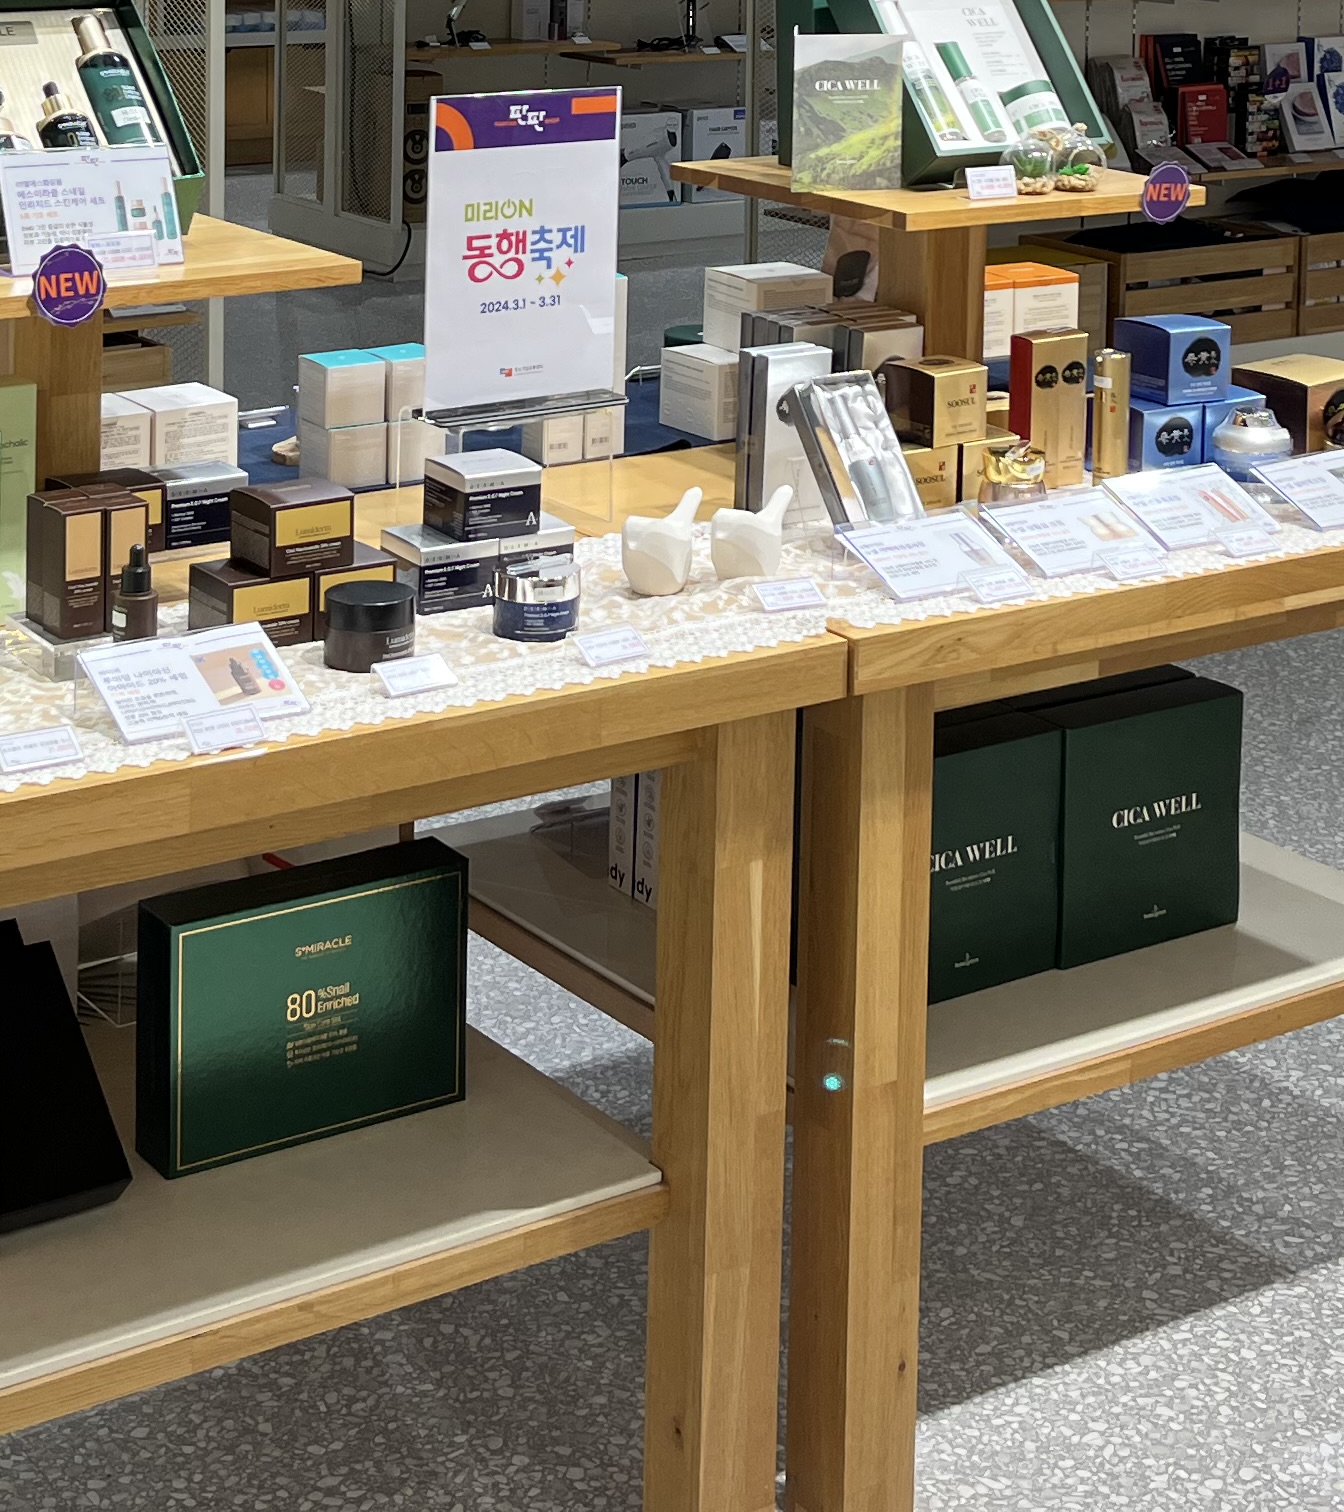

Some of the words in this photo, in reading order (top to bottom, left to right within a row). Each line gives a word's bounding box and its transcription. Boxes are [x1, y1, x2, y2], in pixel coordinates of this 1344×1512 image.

[967, 17, 998, 27] WELL
[815, 80, 843, 91] CICA
[846, 79, 881, 90] WELL
[1267, 76, 1287, 90] 1+1
[621, 177, 648, 185] TOUCH
[1146, 183, 1188, 202] NEW
[462, 224, 586, 283] 동행축제
[39, 270, 99, 300] NEW
[480, 298, 526, 314] 2024.3.1
[539, 295, 561, 308] 3.31
[947, 397, 976, 408] SOOSUL
[915, 474, 945, 486] SOOSUL
[526, 511, 537, 526] A
[295, 525, 331, 536] Lumiderm
[482, 584, 493, 598] A
[1112, 805, 1150, 829] CICA
[1153, 792, 1202, 819] WELL
[966, 835, 1018, 863] WELL
[286, 989, 316, 1022] 80
[317, 992, 360, 1013] Enriched
